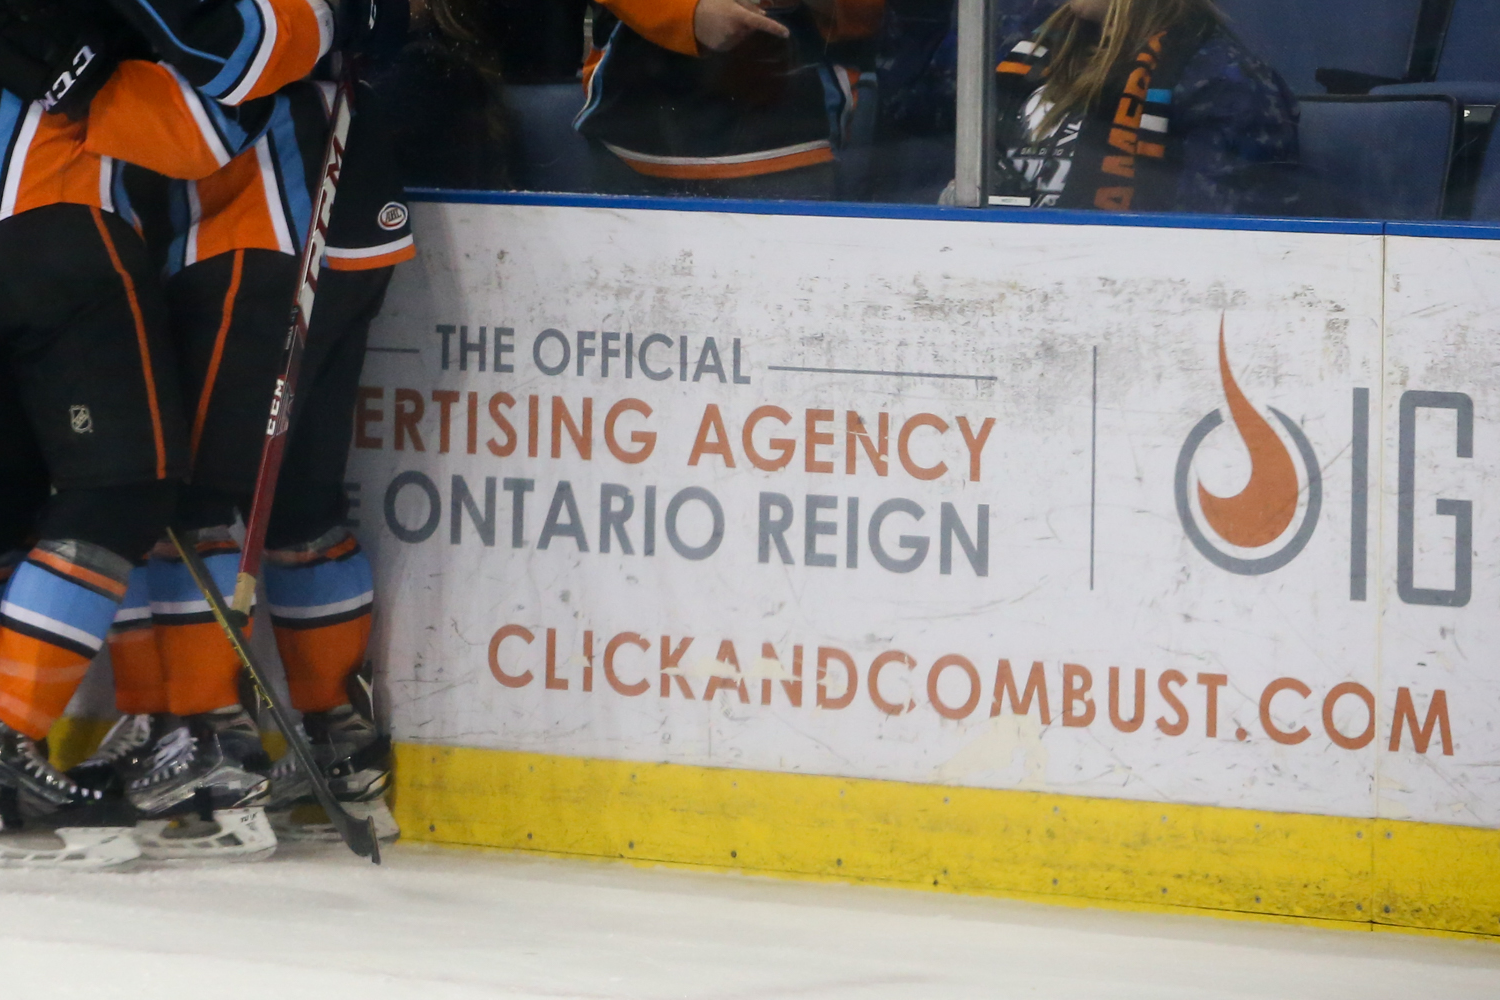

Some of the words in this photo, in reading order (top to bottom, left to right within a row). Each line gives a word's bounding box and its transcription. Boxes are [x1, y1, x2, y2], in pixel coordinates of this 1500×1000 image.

[38, 45, 96, 112] CCM
[384, 207, 402, 224] AHL
[435, 324, 515, 374] THE
[532, 327, 751, 385] OFFICIAL
[265, 377, 286, 437] CCM
[354, 386, 658, 465] ERTISING
[687, 402, 997, 482] AGENCY
[384, 470, 725, 561] ONTARIO
[757, 490, 990, 578] REIGN
[487, 622, 1455, 757] CLICKANDCOMBUST.COM
